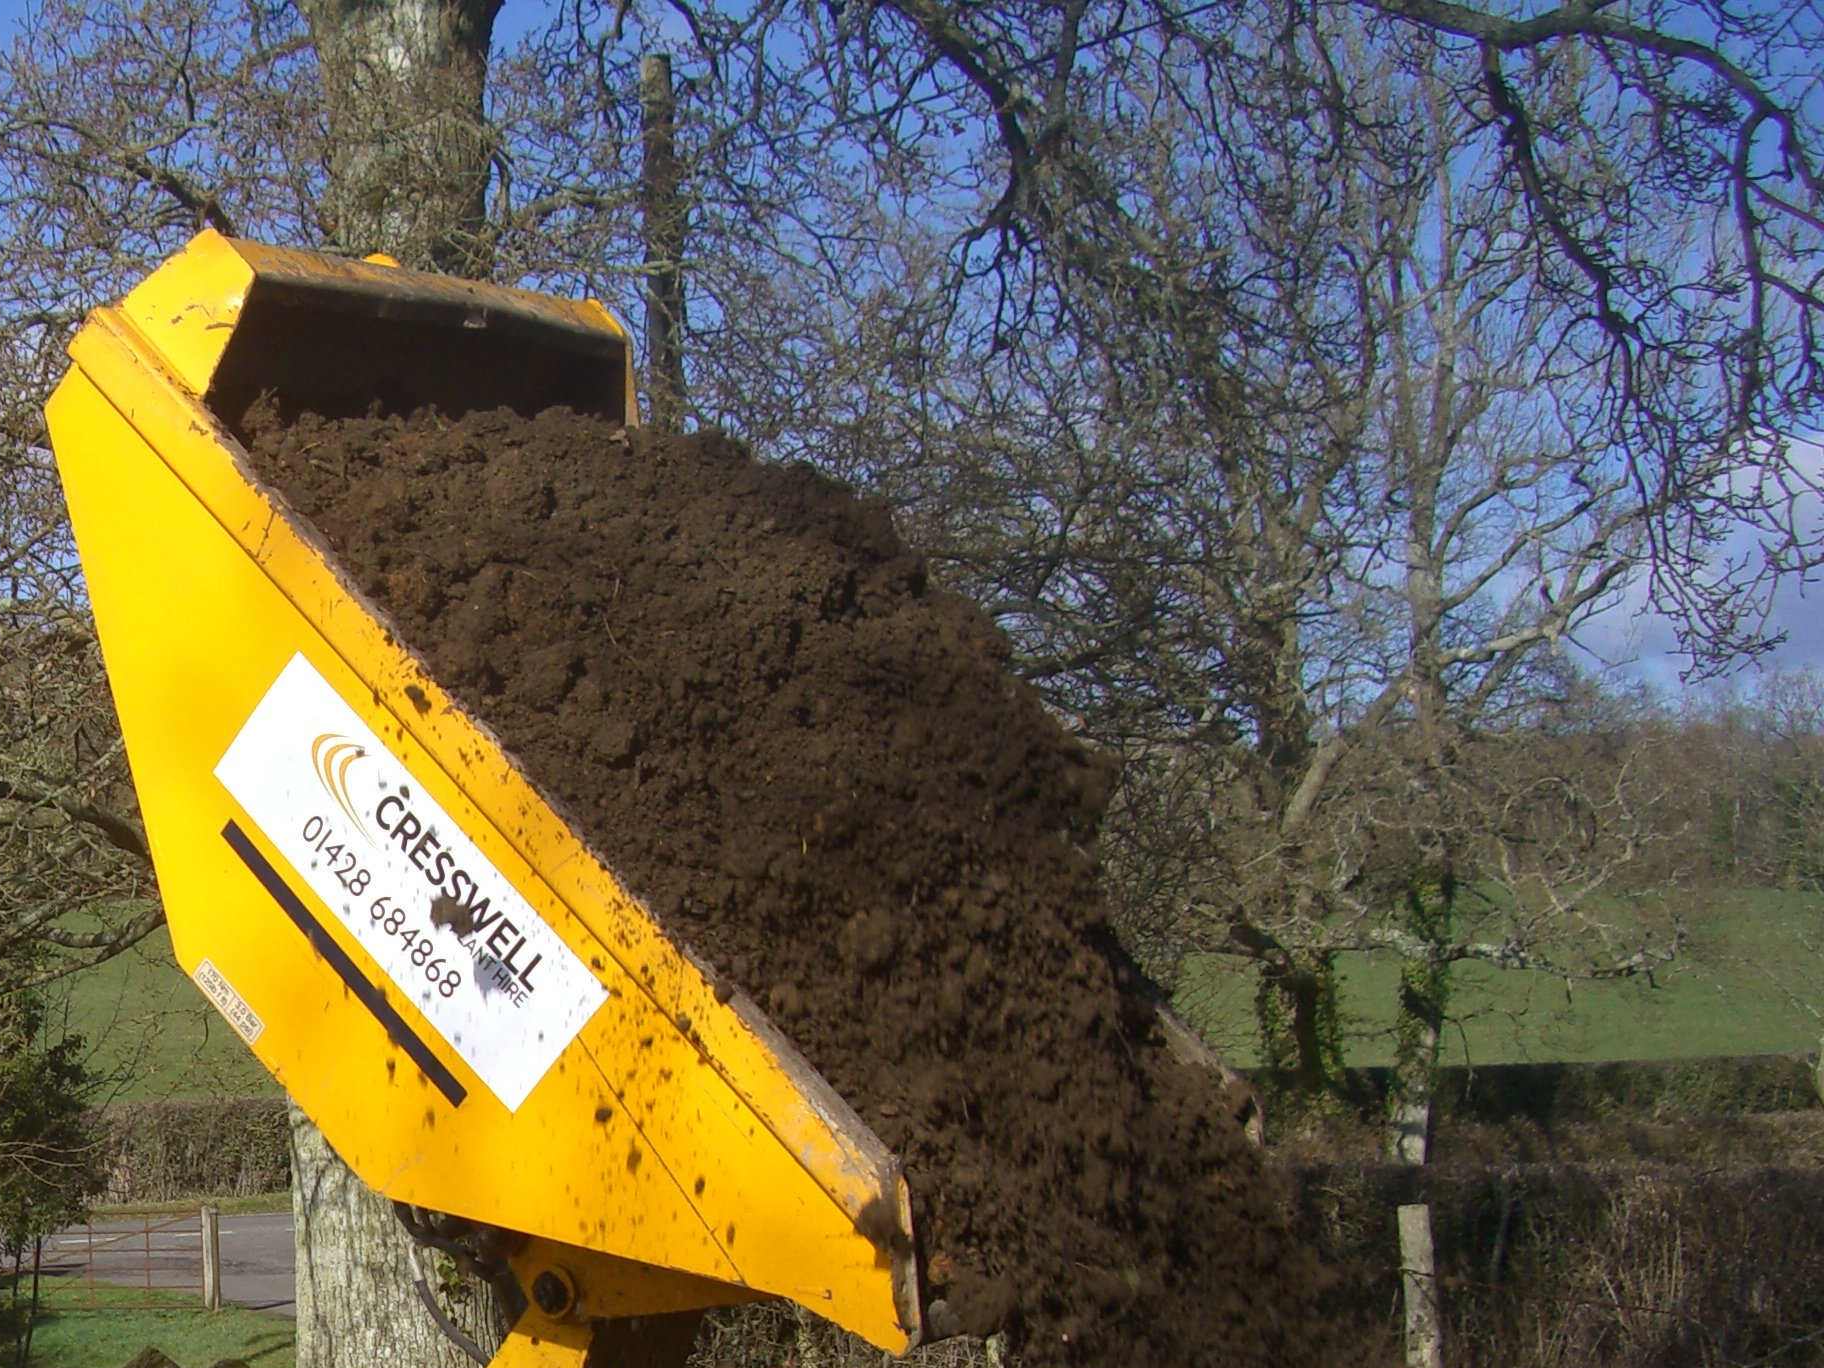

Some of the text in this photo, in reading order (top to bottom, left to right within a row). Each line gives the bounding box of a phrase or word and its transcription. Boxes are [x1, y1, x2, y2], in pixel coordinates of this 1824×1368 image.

[303, 816, 462, 998] 01428 684868
[375, 795, 543, 993] CRESSWELL
[449, 926, 529, 1008] LANT HIRE
